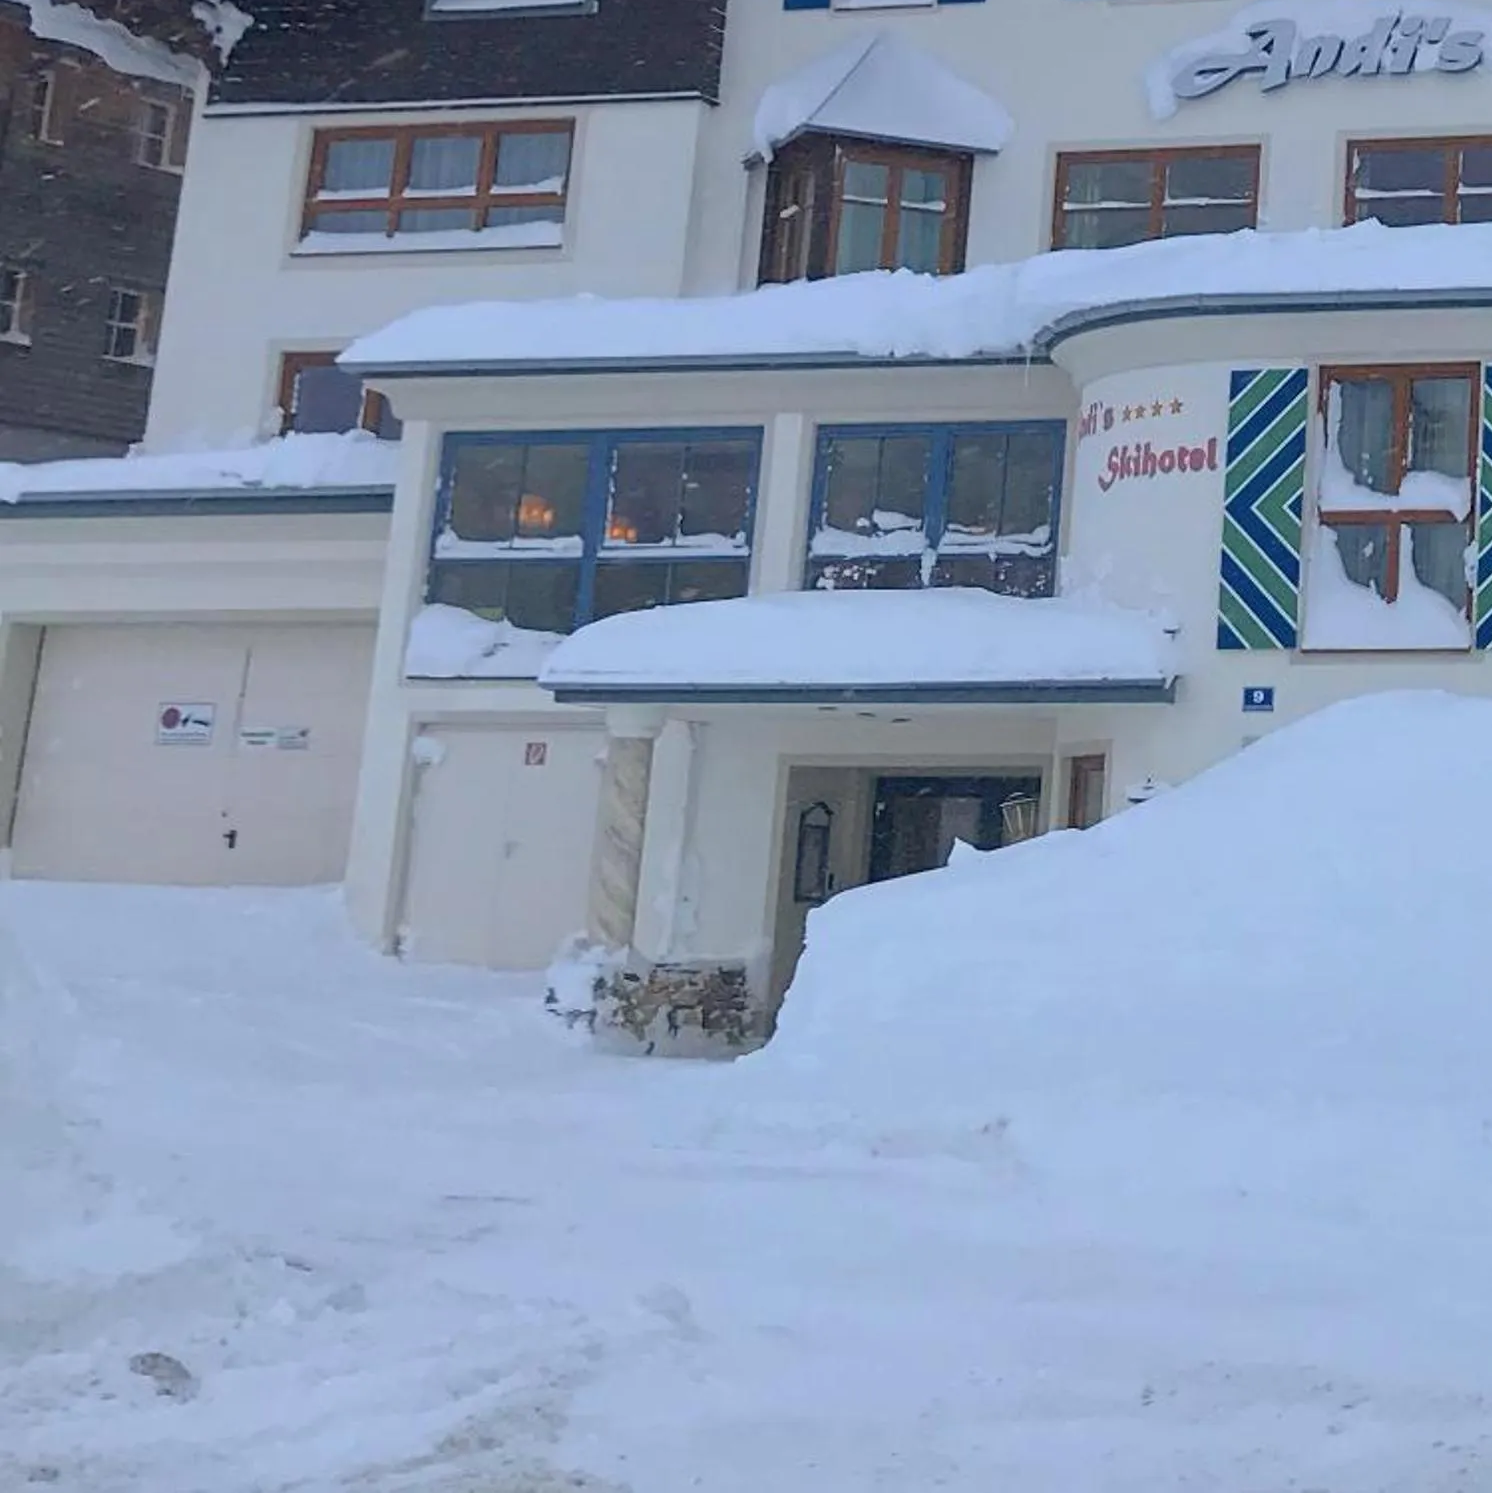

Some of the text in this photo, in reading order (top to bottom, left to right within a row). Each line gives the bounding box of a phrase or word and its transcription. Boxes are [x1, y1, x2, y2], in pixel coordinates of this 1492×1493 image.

[1171, 12, 1485, 98] Andi's
[1098, 436, 1218, 492] Skihotel
[1252, 690, 1265, 704] 9
